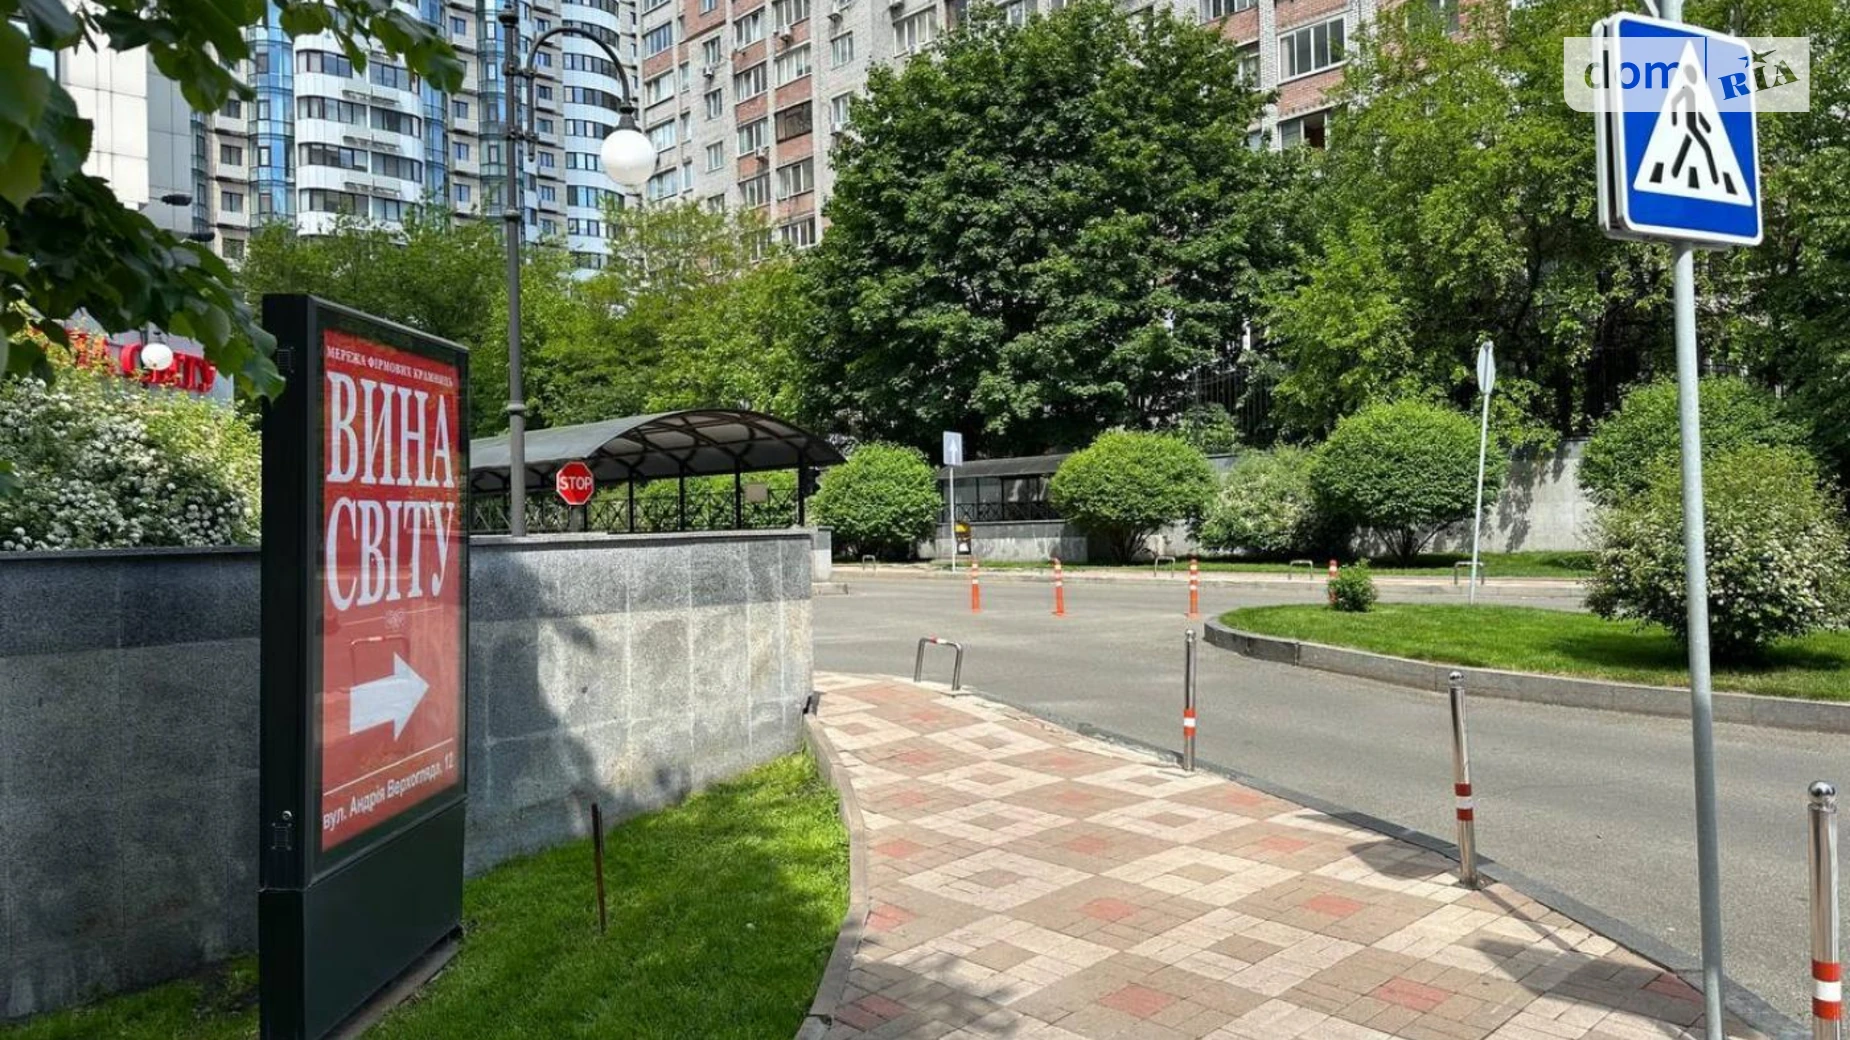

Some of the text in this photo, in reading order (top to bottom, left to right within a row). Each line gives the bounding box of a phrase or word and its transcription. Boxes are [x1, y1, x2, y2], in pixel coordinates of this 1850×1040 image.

[327, 346, 453, 387] МЕРЕЖА ФІРМОВИХ КРАМНИЦЬ
[326, 371, 455, 488] ВИНА
[560, 476, 591, 490] STOP
[326, 496, 455, 611] СВІТУ
[323, 807, 347, 831] вул.
[349, 785, 386, 817] Андрія
[444, 751, 454, 770] 12
